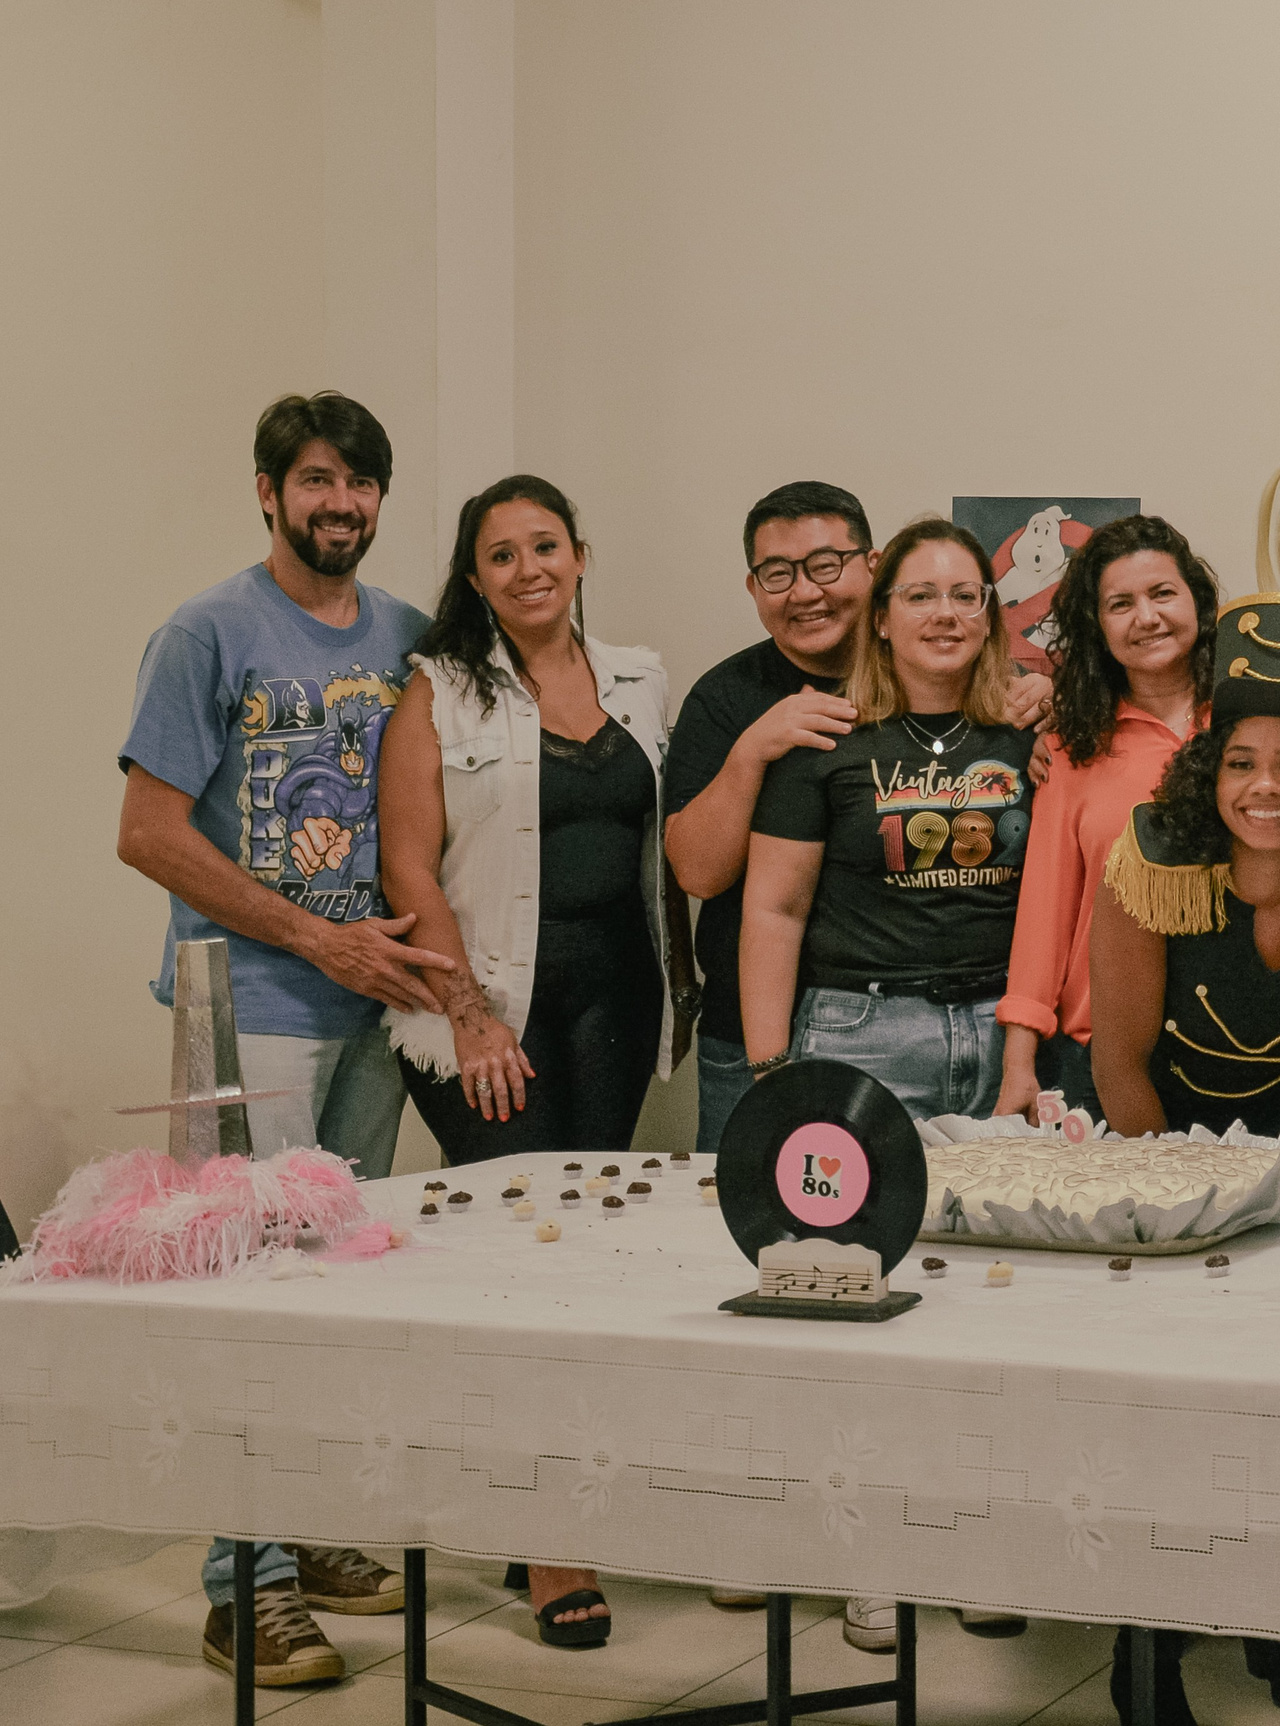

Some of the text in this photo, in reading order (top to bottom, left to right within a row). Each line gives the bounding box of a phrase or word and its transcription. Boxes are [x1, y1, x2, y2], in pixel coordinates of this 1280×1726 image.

[870, 758, 994, 810] Vintage
[250, 749, 286, 870] DUKE
[894, 866, 1014, 888] LIMITED EDITION
[1036, 1089, 1094, 1145] 50
[802, 1154, 815, 1176] I
[801, 1177, 840, 1199] 80s
